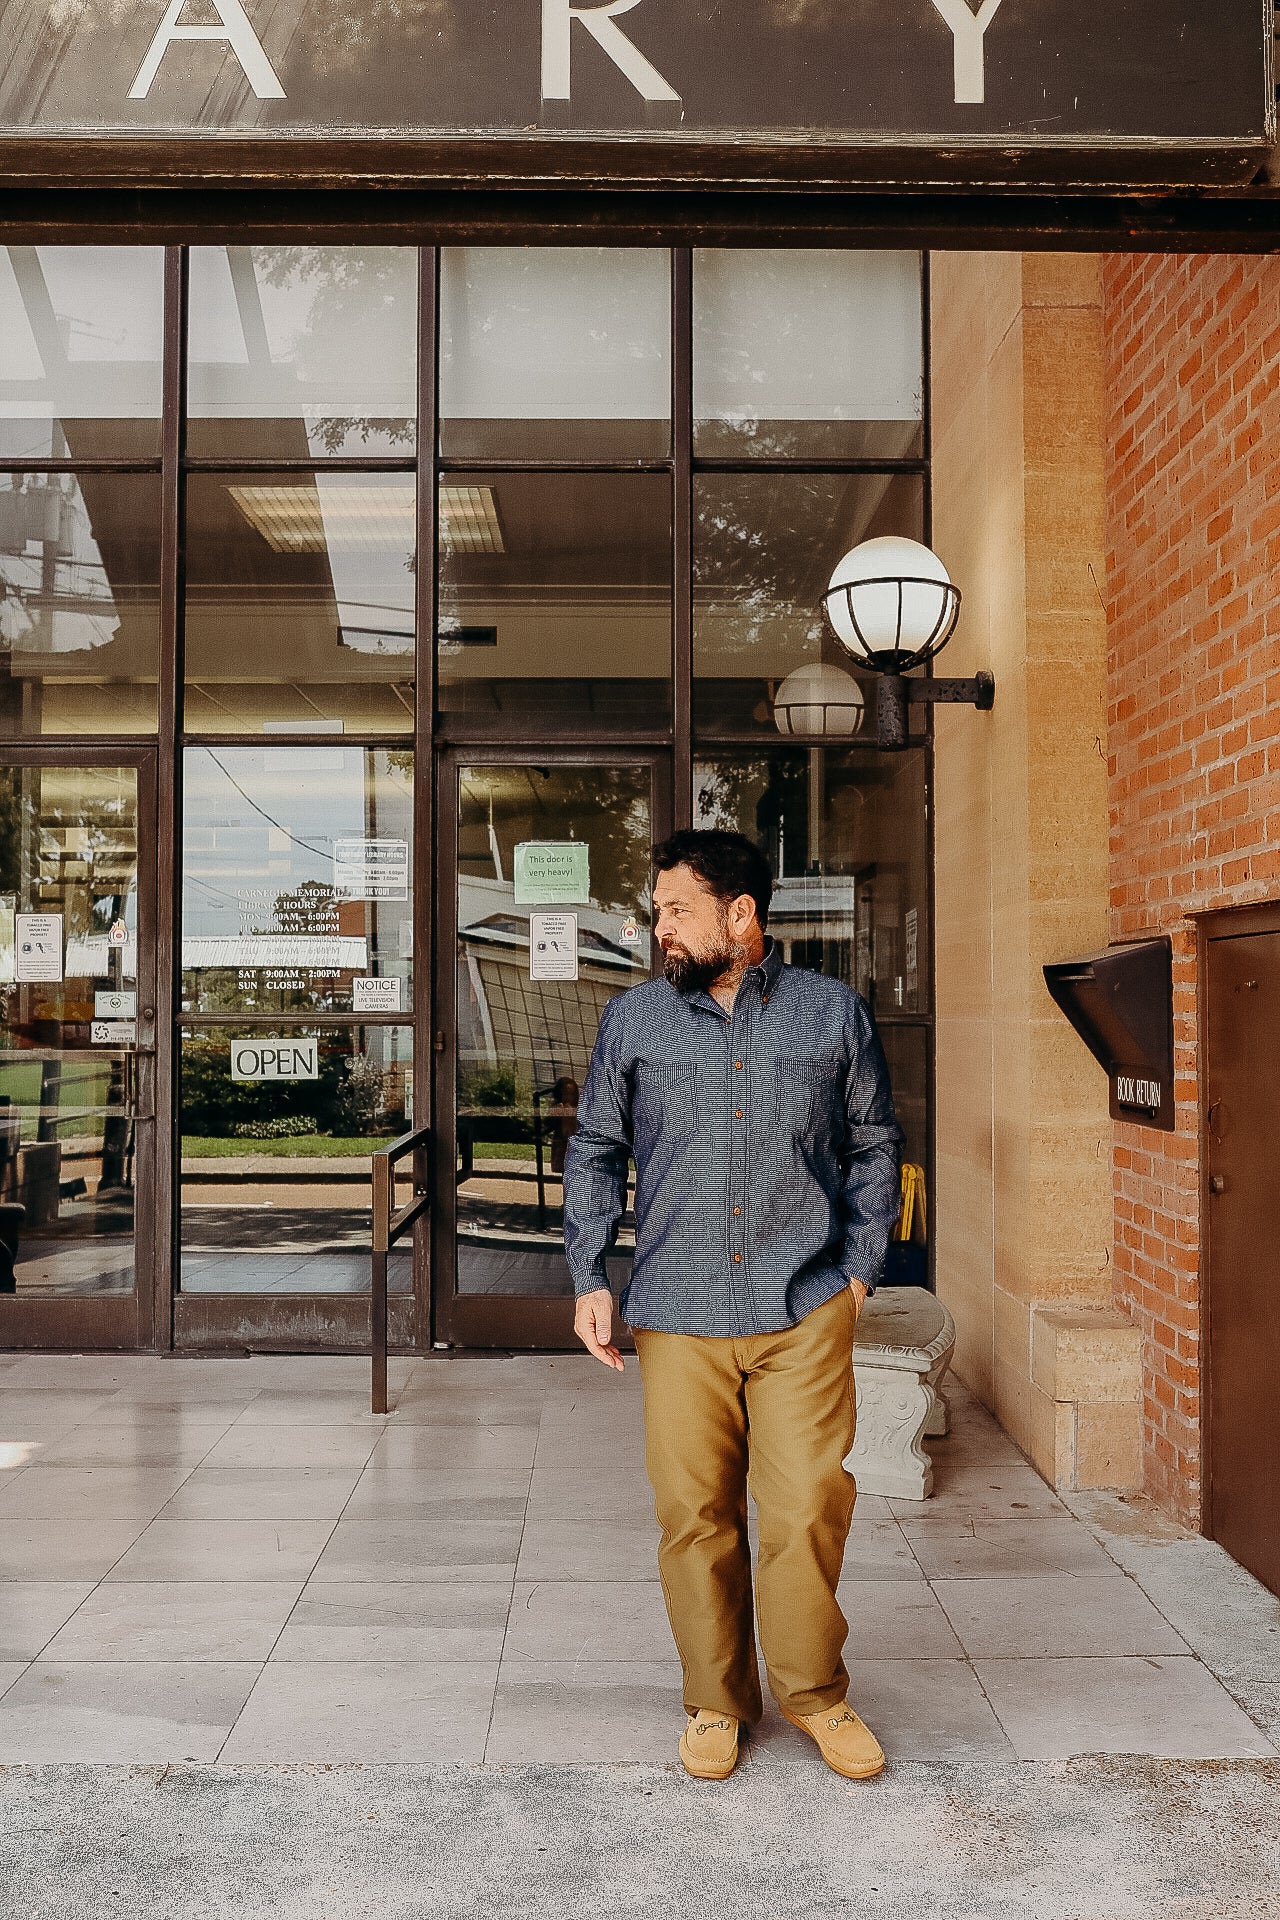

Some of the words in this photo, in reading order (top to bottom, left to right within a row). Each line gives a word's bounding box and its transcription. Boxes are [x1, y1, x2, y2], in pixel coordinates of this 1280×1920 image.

[530, 855, 545, 863] This
[546, 855, 565, 863] door
[566, 855, 573, 863] is
[529, 870, 546, 878] very
[547, 868, 573, 877] heavy!
[290, 888, 344, 897] MEMORIAL
[352, 887, 374, 896] THANK
[238, 900, 281, 909] LIBRARY
[283, 900, 317, 909] HOURS
[239, 912, 260, 921] MON
[266, 912, 299, 921] 9:00AM
[307, 912, 340, 921] 6:00PM
[240, 923, 258, 932] TUE
[266, 923, 299, 932] 9:00AM
[307, 923, 340, 932] 6:00PM
[238, 970, 257, 978] SAT
[266, 970, 299, 978] 9:00AM
[308, 970, 341, 978] 2:00PM
[238, 981, 258, 990] SUN
[266, 981, 305, 990] CLOSED
[356, 980, 396, 990] NOTICE
[236, 1048, 313, 1076] OPEN
[1117, 1076, 1135, 1103] BOOK
[1136, 1079, 1161, 1108] RETURN
